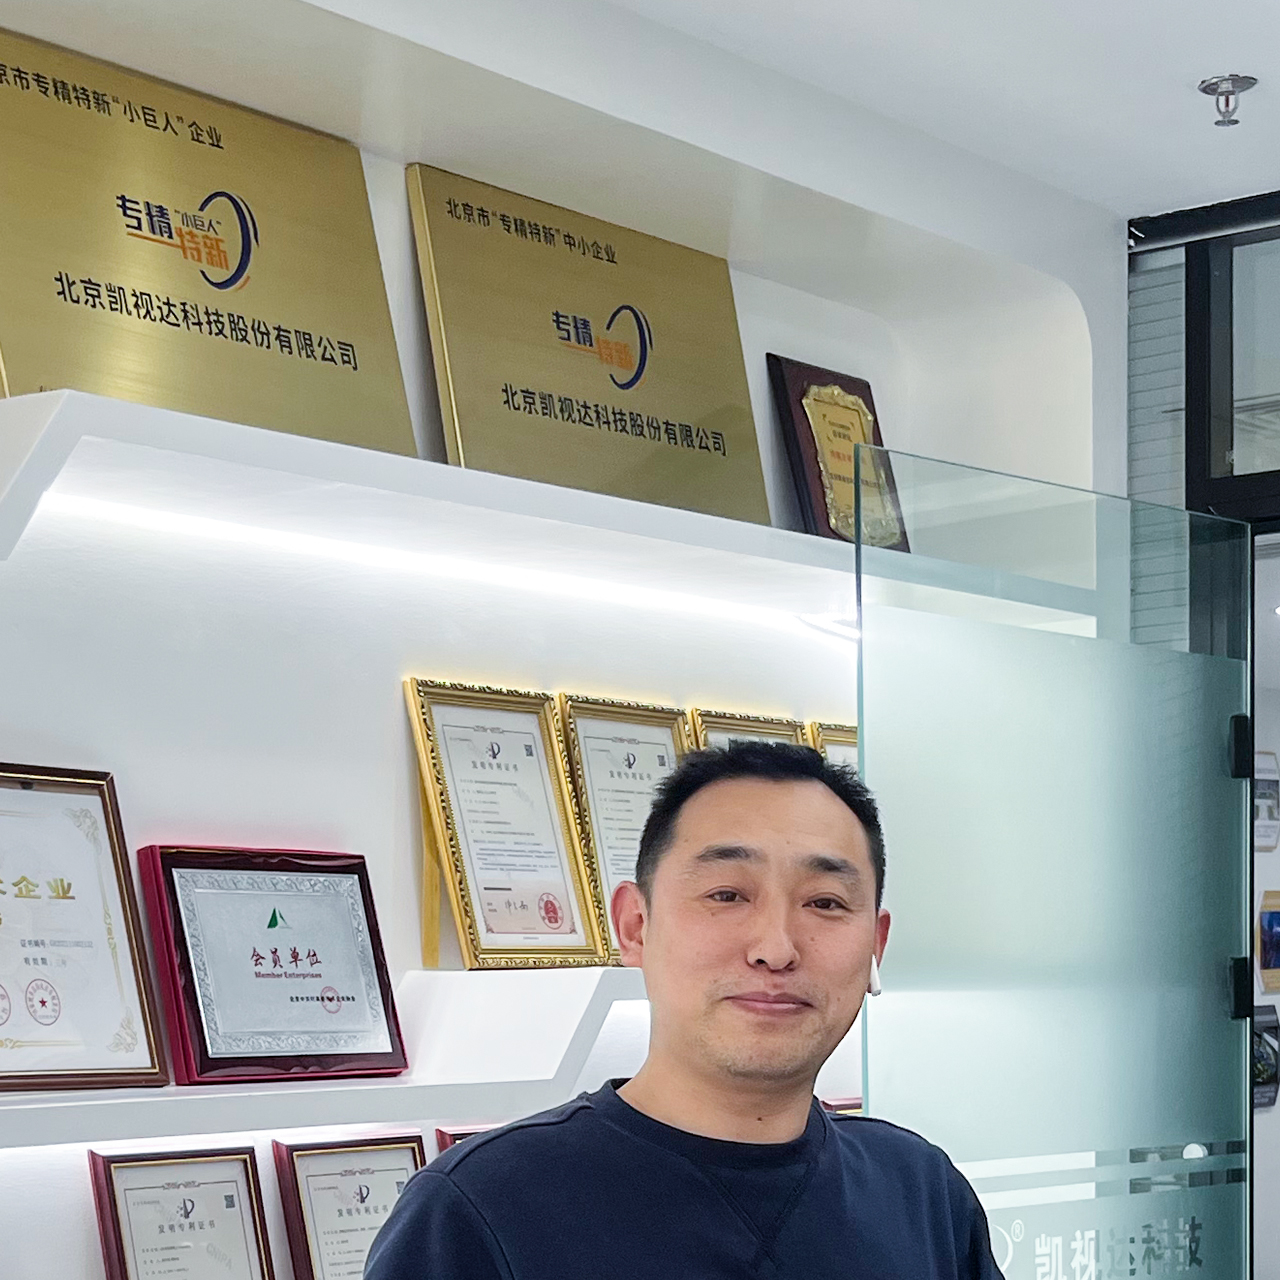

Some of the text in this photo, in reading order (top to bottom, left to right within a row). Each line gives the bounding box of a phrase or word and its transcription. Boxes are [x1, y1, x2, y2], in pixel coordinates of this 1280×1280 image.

[116, 194, 174, 240] 专精
[446, 197, 618, 265] 北京市“专精特新”中小企业
[175, 226, 230, 271] 特新
[54, 271, 359, 371] 北京凯视达科技股份有限公司
[551, 309, 595, 348] 专精
[501, 382, 728, 458] 北京凯视达科技股份有限公司
[251, 946, 322, 969] 会员单位
[254, 971, 322, 980] Member Enterprises
